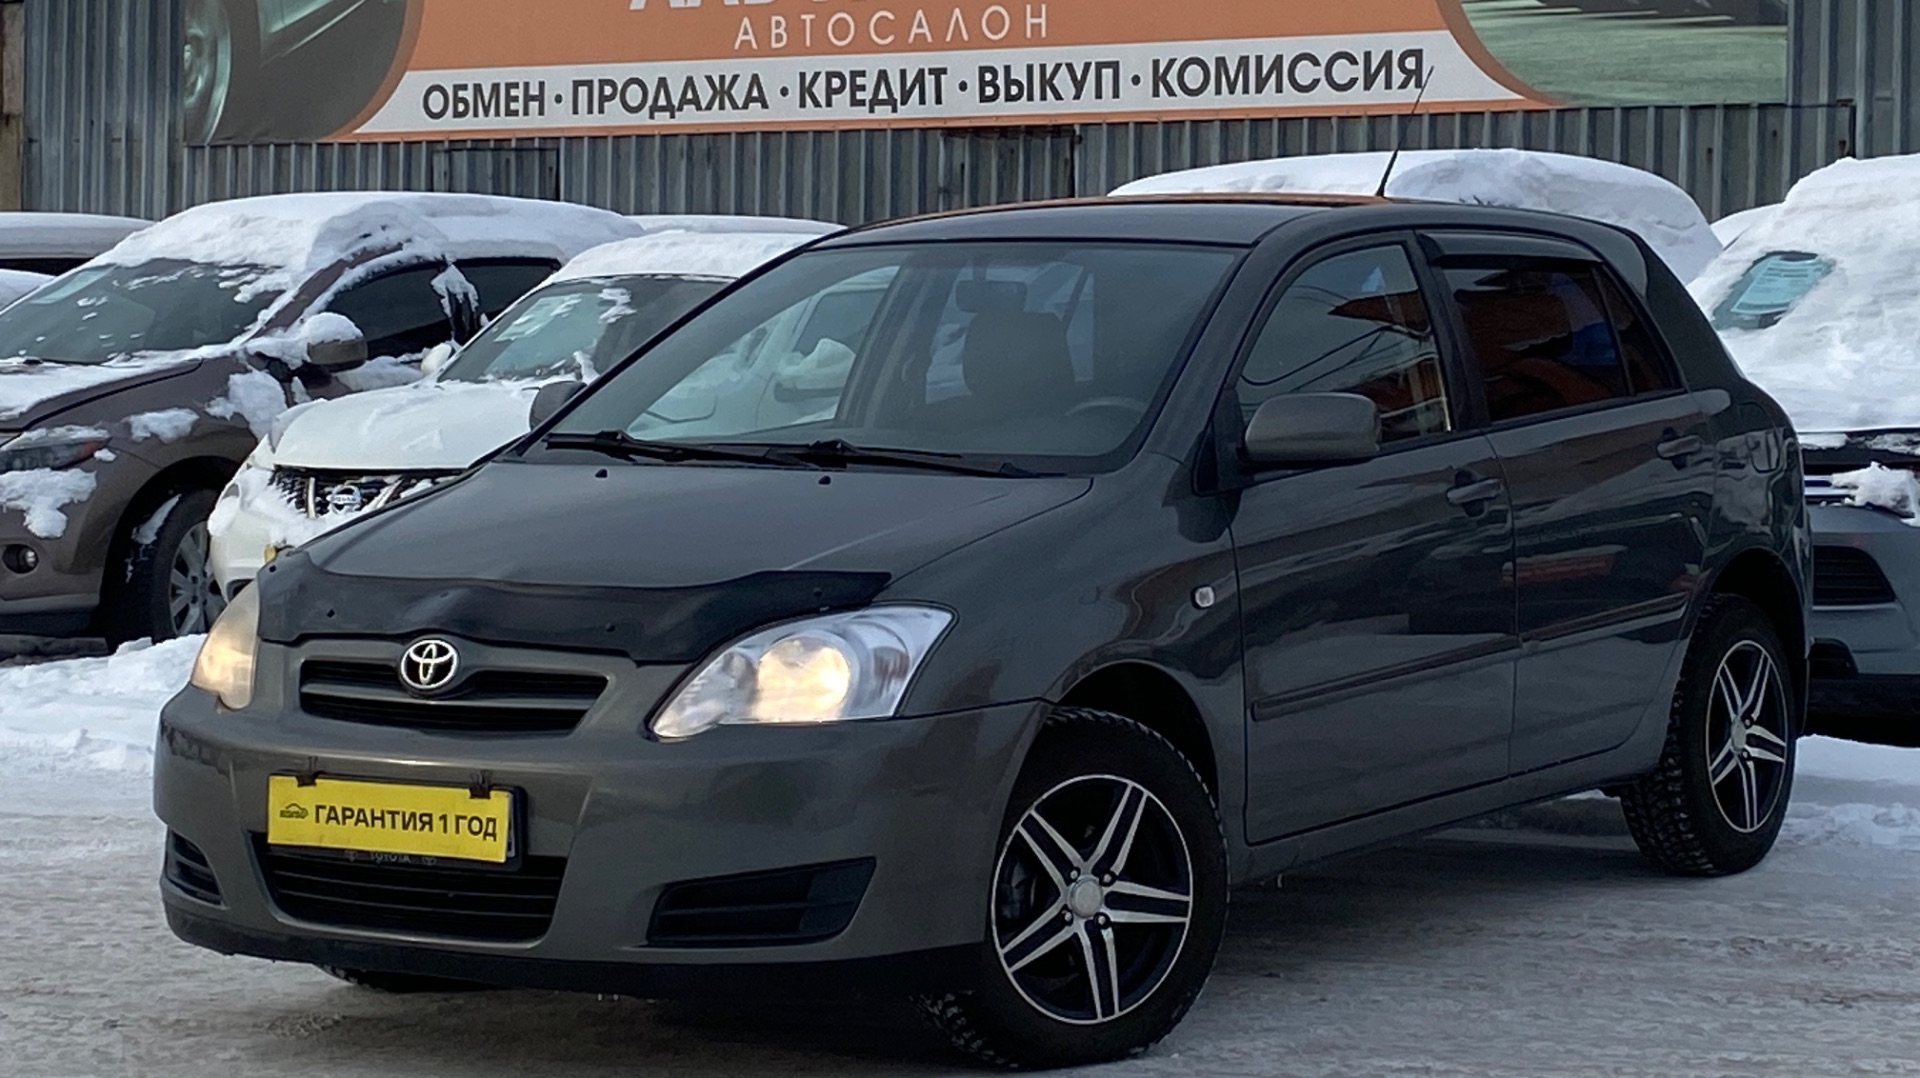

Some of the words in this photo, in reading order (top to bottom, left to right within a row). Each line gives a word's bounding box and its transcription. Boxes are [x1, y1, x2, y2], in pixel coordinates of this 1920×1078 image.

[733, 4, 1048, 50] АВТОСАЛОН
[422, 80, 546, 119] ОБМЕН
[572, 73, 769, 119] ПРОДАЖА
[798, 67, 947, 113] КРЕДИТ
[977, 60, 1120, 103] ВЫКУП
[1152, 48, 1424, 98] КОМИССИЯ
[315, 805, 433, 832] ГАРАНТИЯ
[439, 814, 448, 834] 1
[455, 815, 497, 842] ГОД
